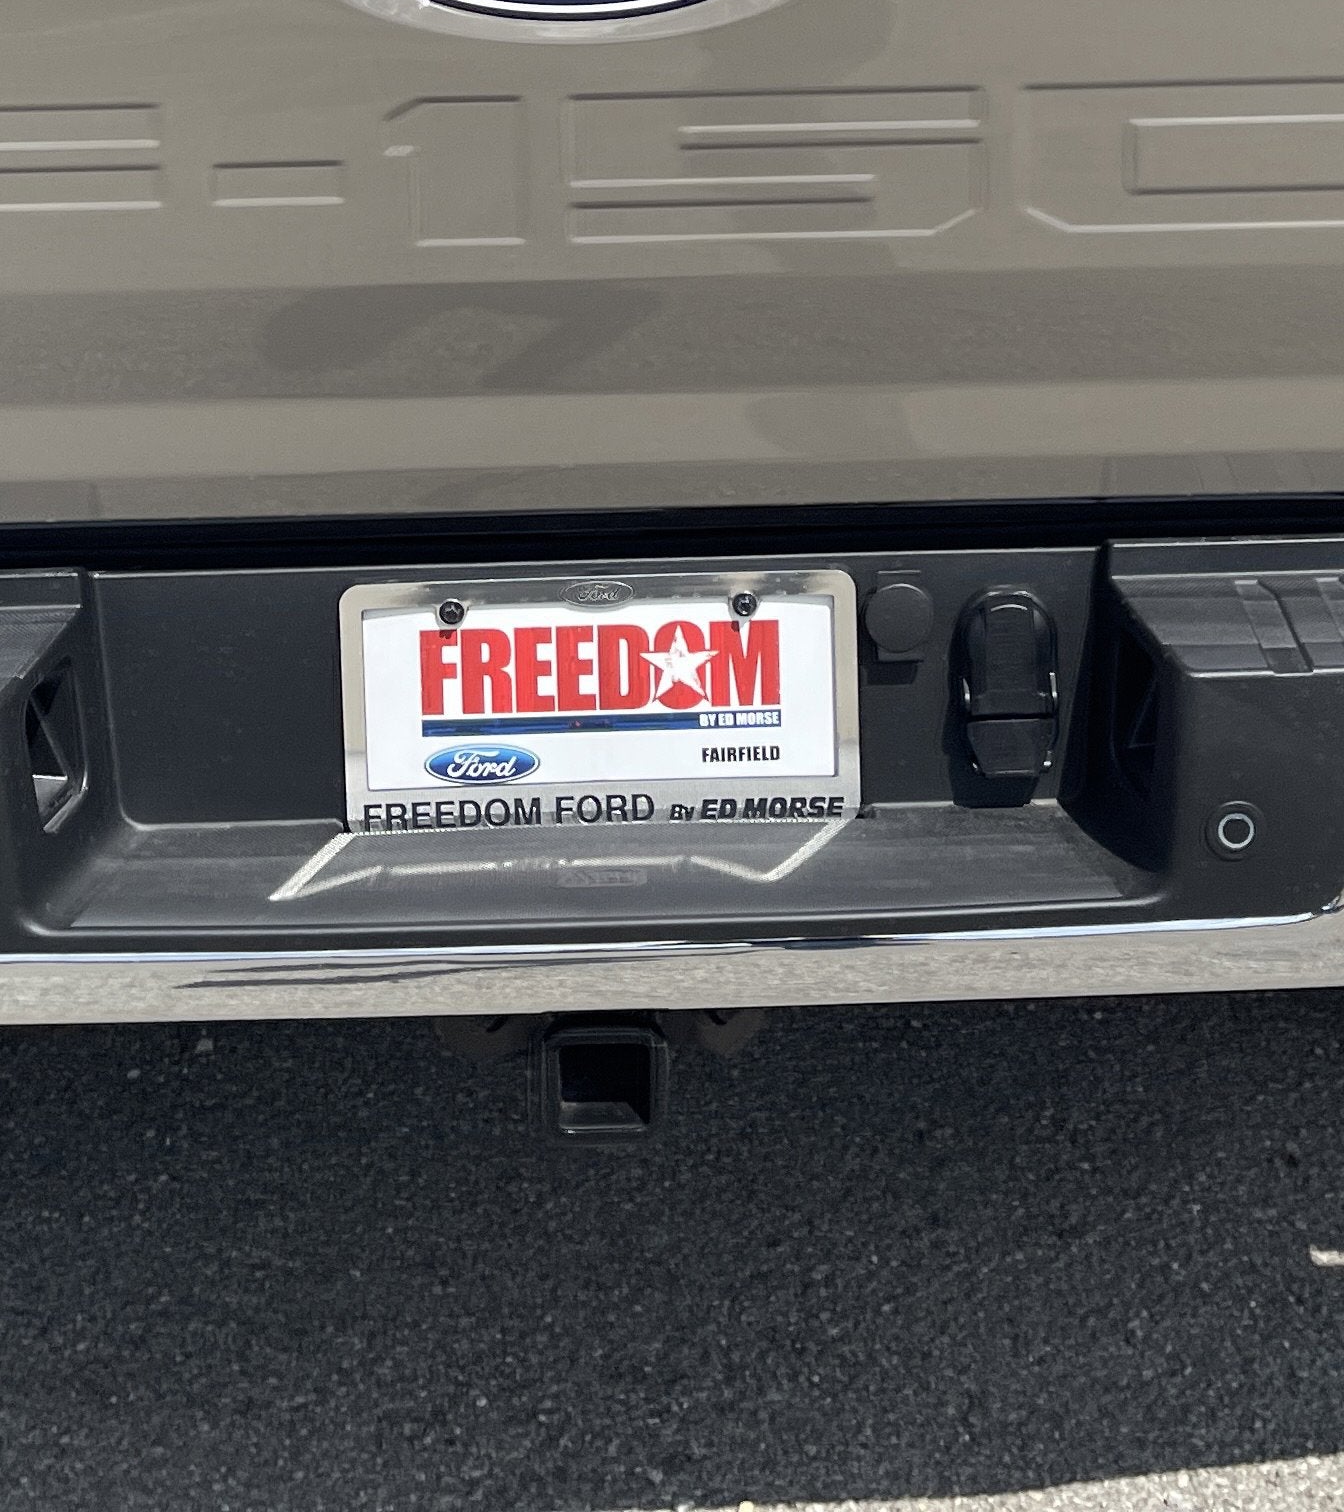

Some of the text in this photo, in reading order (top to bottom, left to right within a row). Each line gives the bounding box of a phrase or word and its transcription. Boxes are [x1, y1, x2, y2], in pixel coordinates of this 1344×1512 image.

[577, 584, 622, 602] Ford
[419, 619, 781, 716] FREEDOM
[699, 711, 780, 727] BY ED MORSE
[446, 750, 517, 777] Ford
[702, 745, 781, 763] FAIRFIELD
[363, 796, 542, 831] FREEDOM
[555, 793, 655, 824] FORD
[700, 798, 737, 820] ED
[742, 796, 845, 819] MORSE
